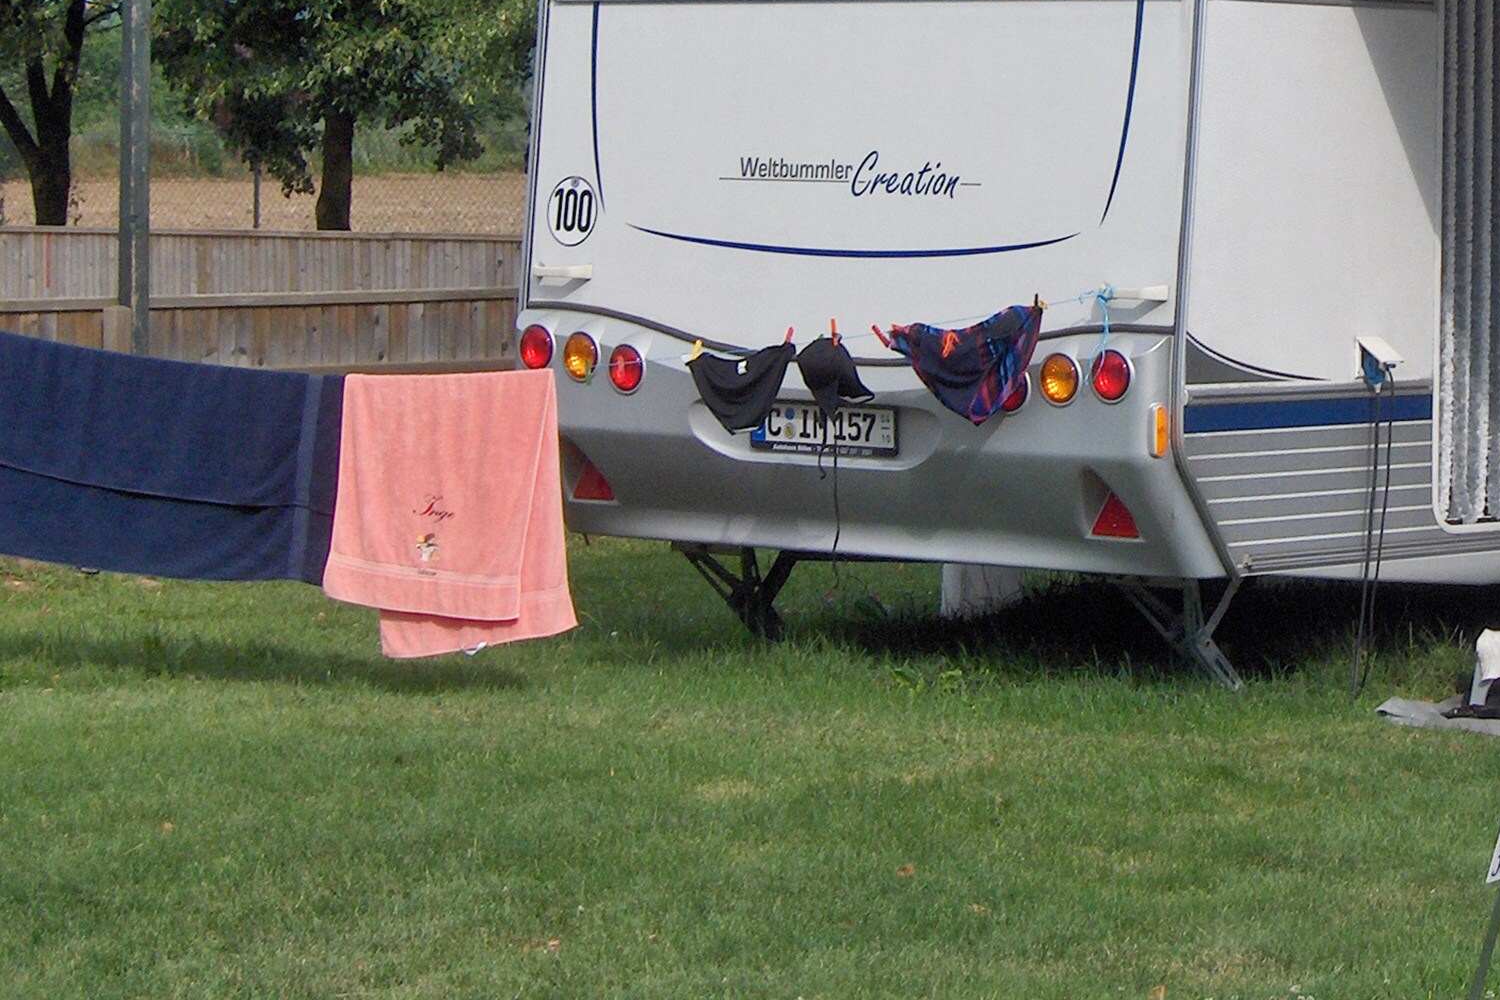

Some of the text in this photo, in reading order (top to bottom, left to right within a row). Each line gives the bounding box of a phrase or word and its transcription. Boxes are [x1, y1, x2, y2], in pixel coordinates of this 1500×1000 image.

[740, 150, 960, 199] Weltbummler Creation
[554, 187, 593, 233] 100
[768, 408, 782, 437] C
[833, 410, 876, 442] 157
